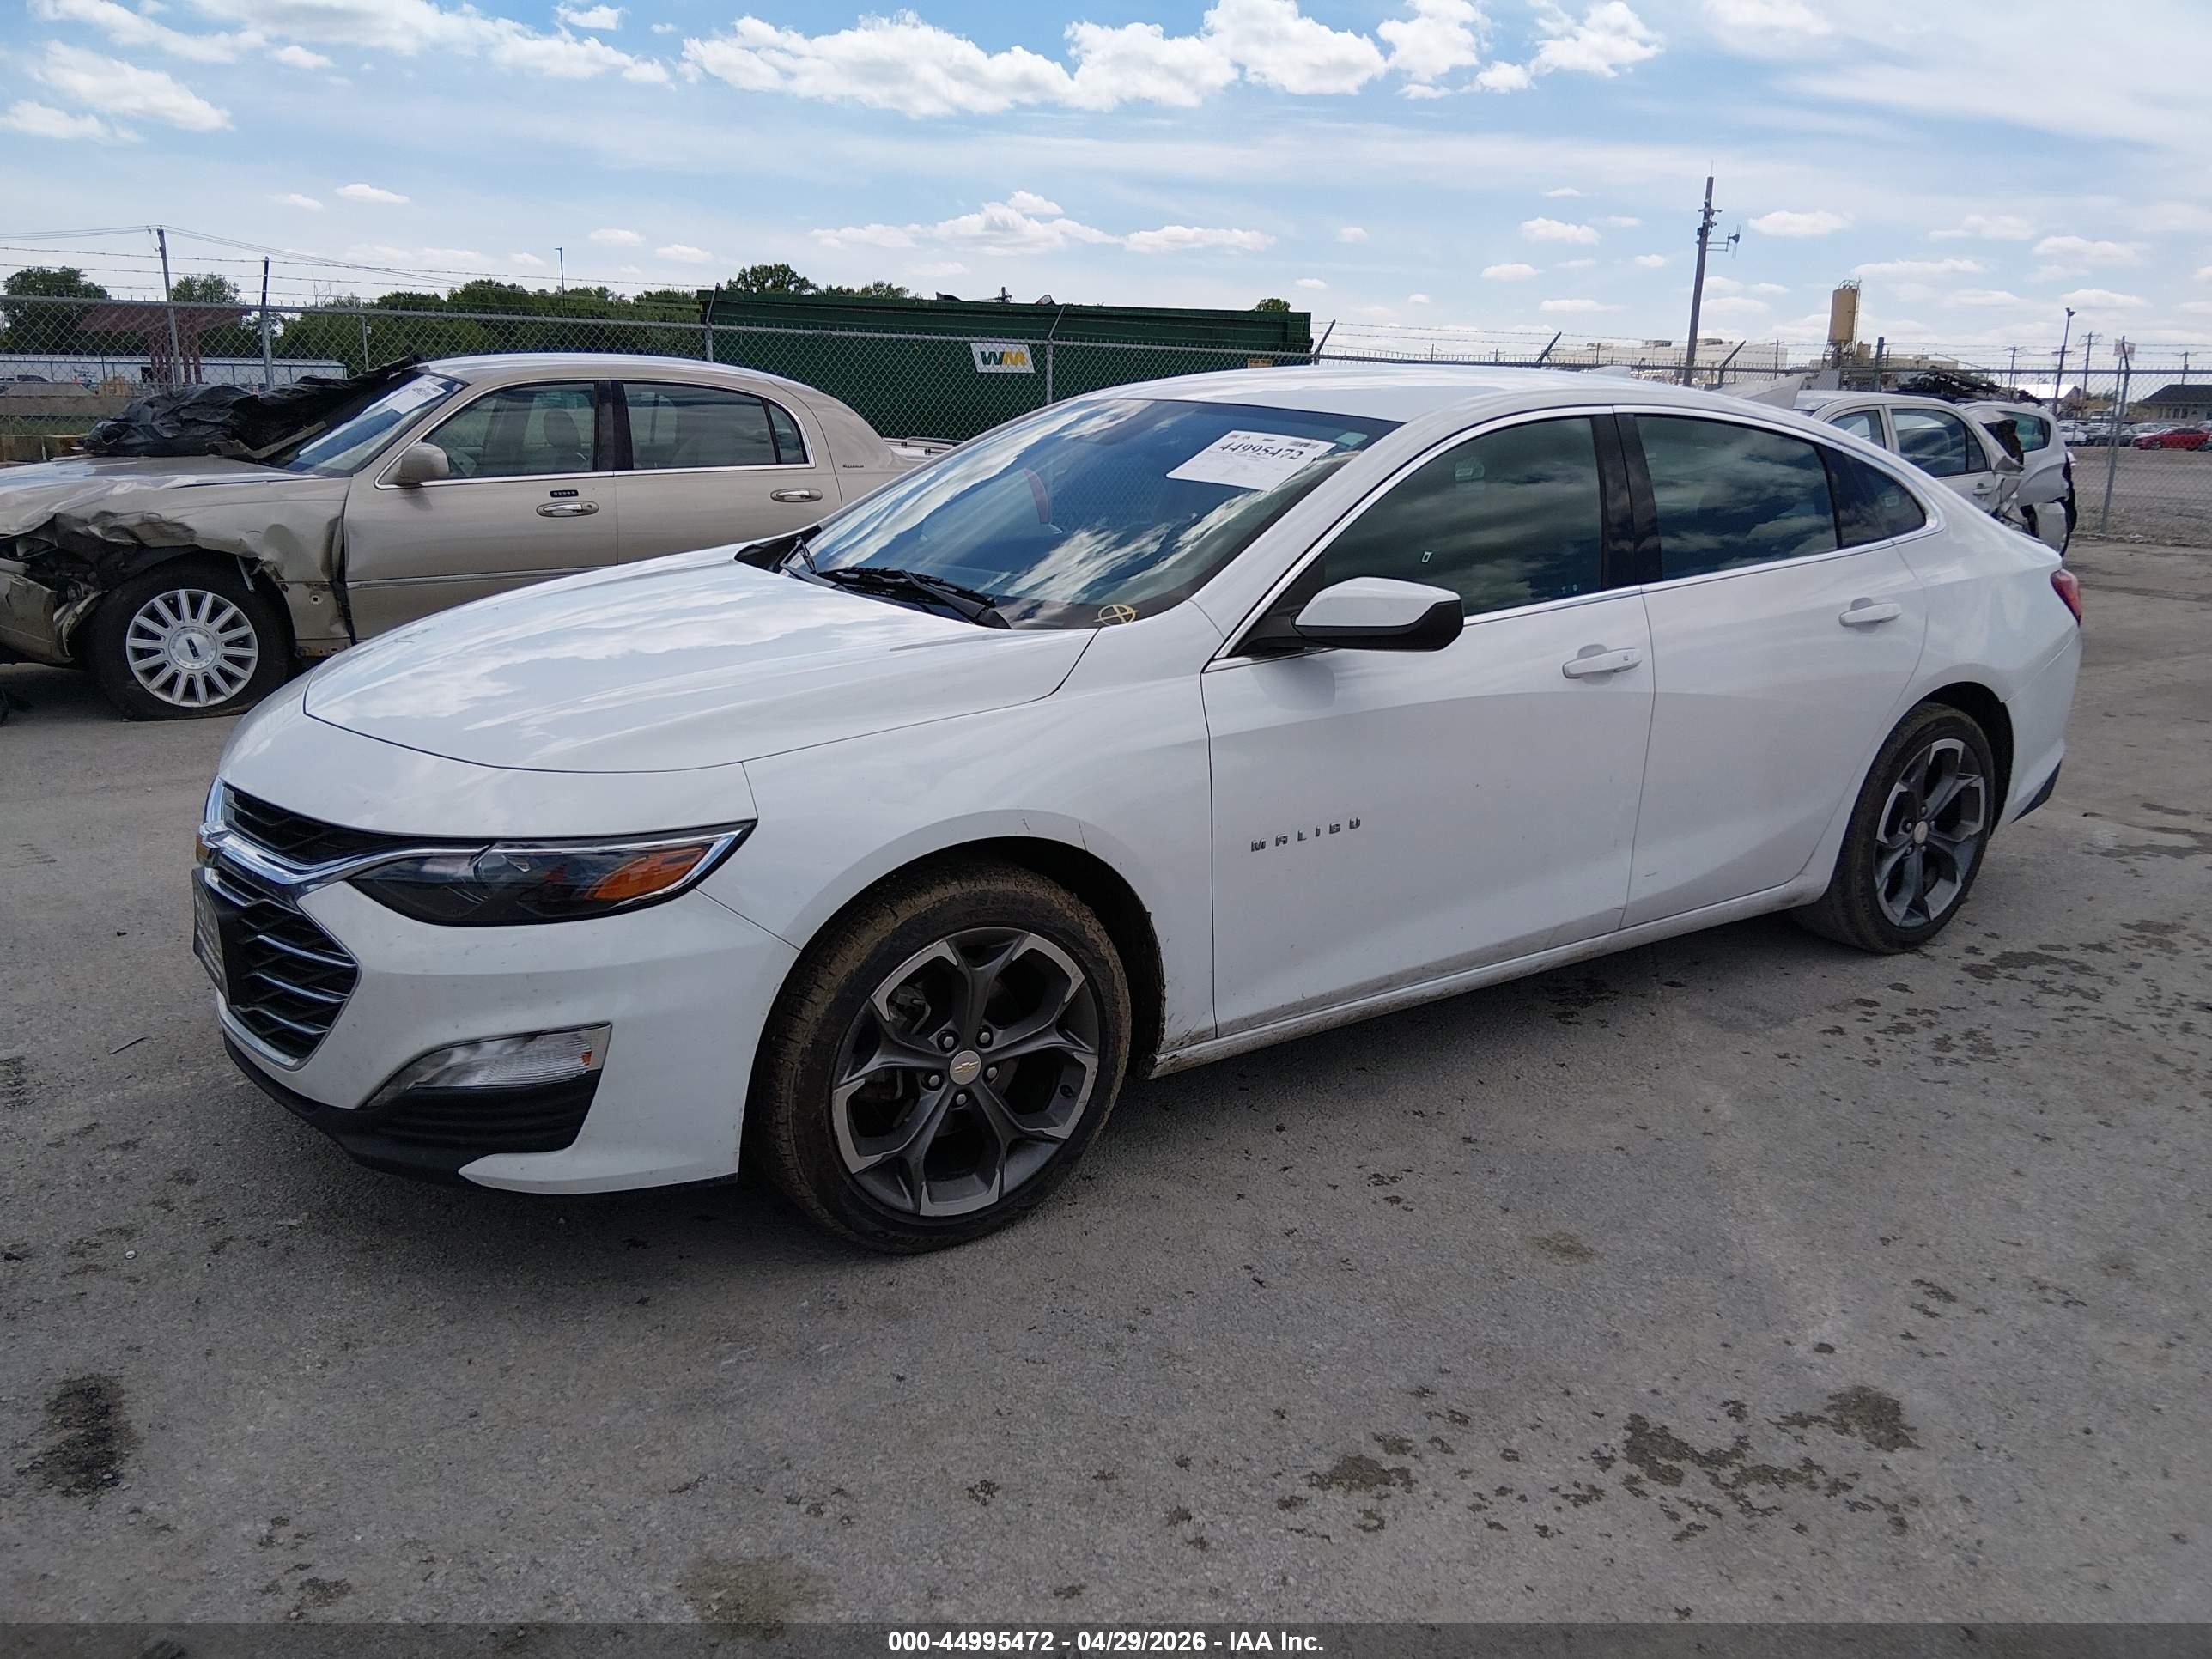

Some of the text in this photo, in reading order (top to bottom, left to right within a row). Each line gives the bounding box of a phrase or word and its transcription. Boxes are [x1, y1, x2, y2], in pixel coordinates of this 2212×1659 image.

[980, 350, 1028, 366] WM
[1219, 441, 1305, 460] 44995472
[1250, 817, 1361, 852] MALIBU
